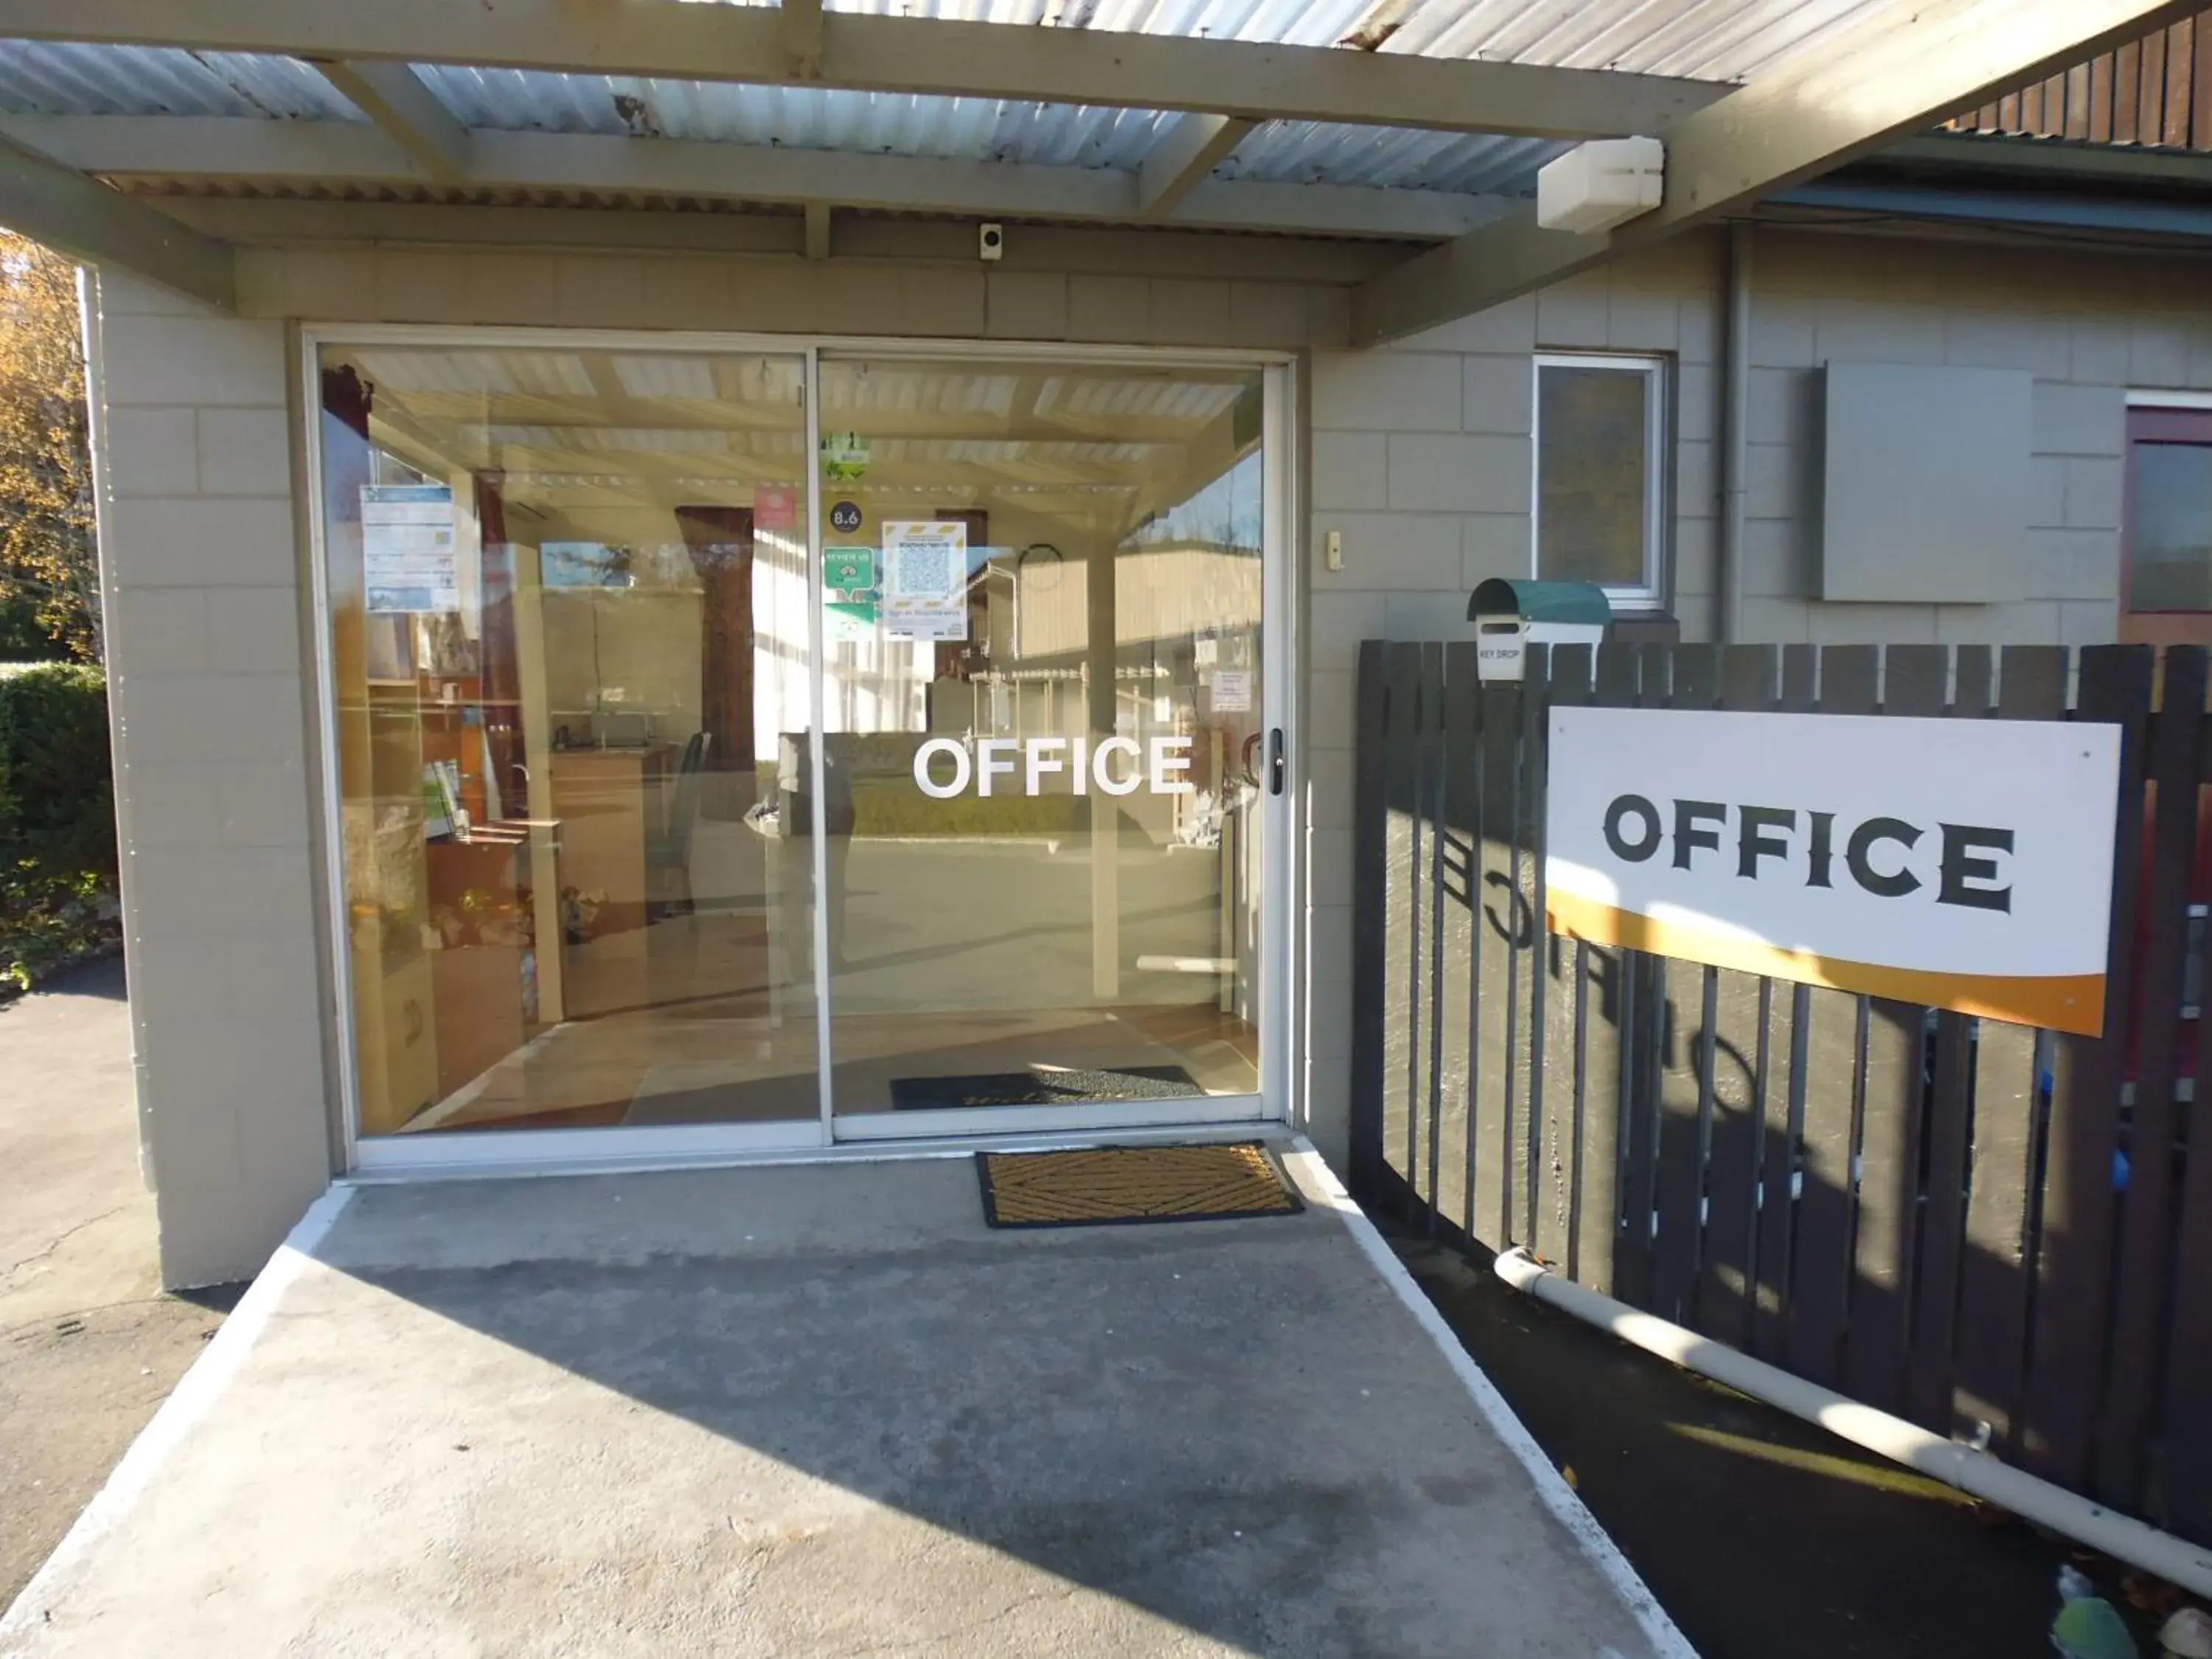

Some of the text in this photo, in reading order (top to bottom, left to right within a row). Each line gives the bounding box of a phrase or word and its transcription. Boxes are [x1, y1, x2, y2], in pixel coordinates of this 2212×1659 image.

[834, 511, 858, 525] 8.6
[1479, 650, 1520, 660] KEY DROP
[914, 737, 1193, 799] OFFICE
[1603, 793, 2015, 915] OFFICE
